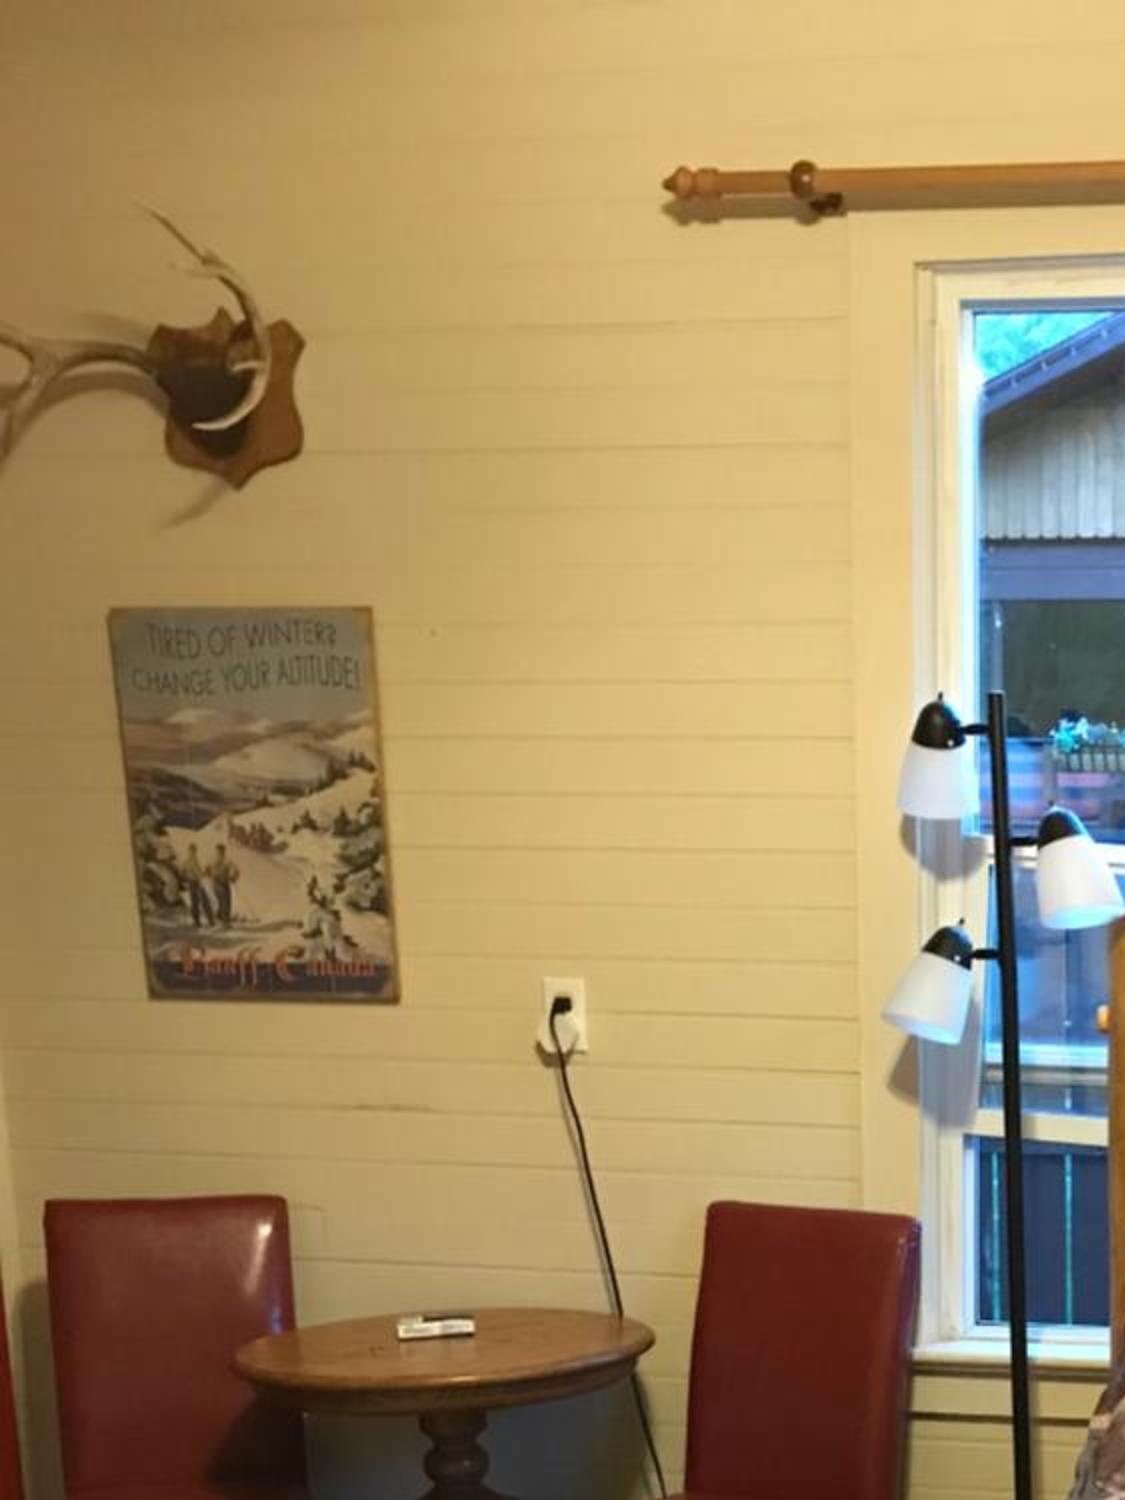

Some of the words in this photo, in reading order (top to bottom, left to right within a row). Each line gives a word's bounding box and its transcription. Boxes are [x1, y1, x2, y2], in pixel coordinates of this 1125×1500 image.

[144, 622, 200, 660] TIRED
[207, 625, 236, 657] OF
[244, 618, 336, 649] WINTER?
[131, 666, 217, 697] CHANGE
[223, 660, 270, 693] YOUR
